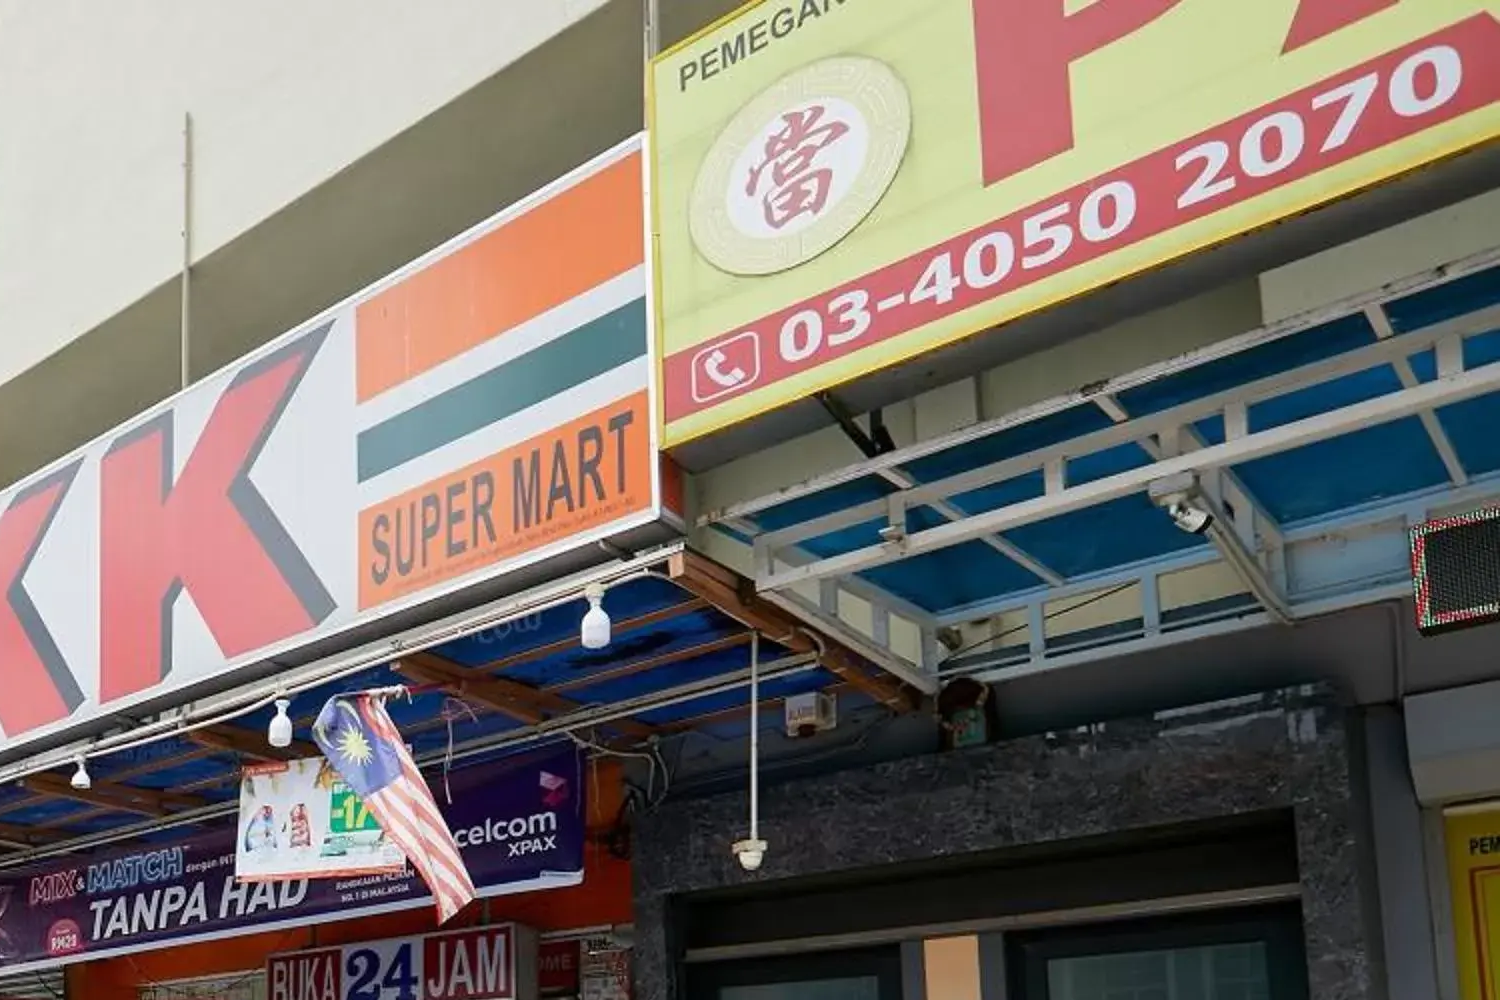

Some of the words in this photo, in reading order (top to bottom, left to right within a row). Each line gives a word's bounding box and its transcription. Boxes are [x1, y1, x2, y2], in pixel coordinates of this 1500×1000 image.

[744, 104, 851, 230] 當
[778, 180, 1138, 363] 03-4050
[1174, 45, 1463, 210] 2070
[370, 470, 498, 586] SUPER
[512, 408, 635, 534] MART
[453, 811, 557, 849] celcom
[507, 835, 557, 858] XPAX
[28, 869, 78, 905] MIX
[77, 877, 86, 892] &
[87, 846, 184, 893] MATCH
[89, 881, 208, 941] TANPA
[427, 933, 507, 999] JAM
